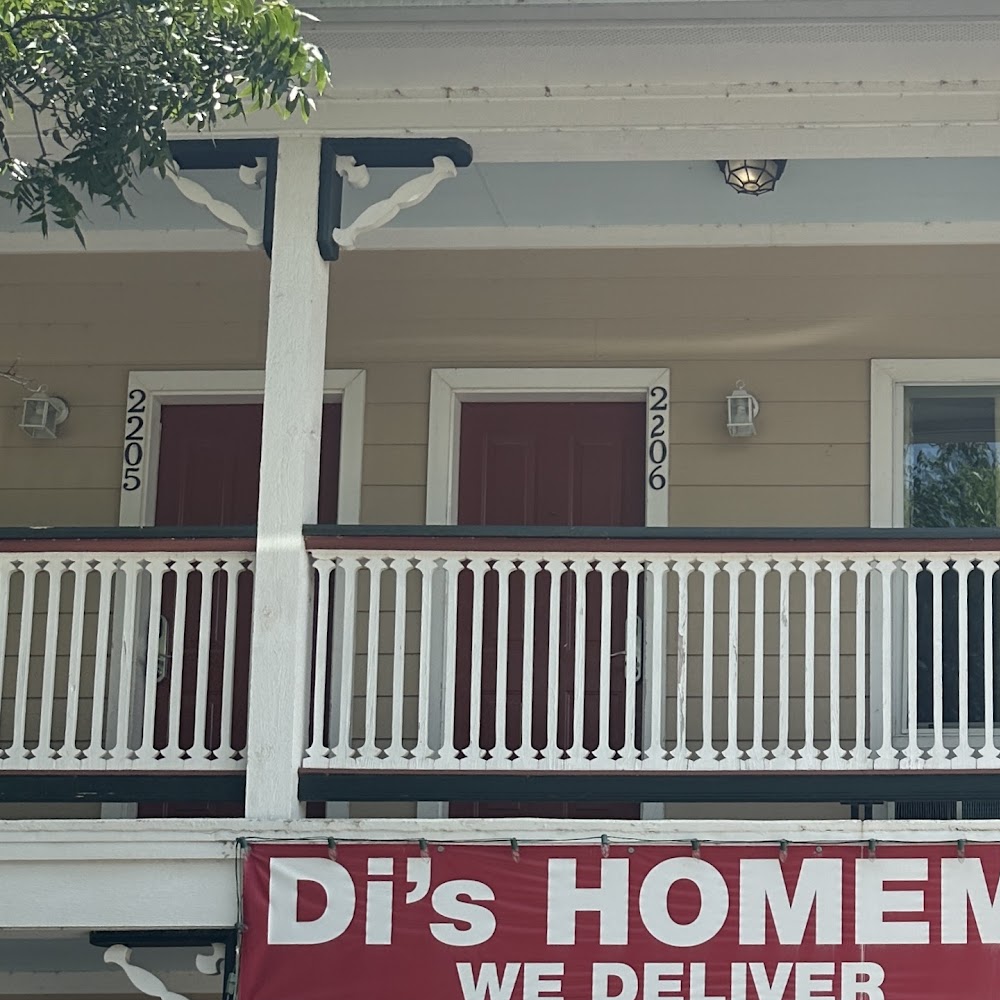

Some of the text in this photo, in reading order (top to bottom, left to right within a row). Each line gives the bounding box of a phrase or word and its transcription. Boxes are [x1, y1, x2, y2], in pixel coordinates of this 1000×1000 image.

[123, 389, 146, 491] 2205
[649, 386, 668, 490] 2206
[267, 857, 497, 947] Di's
